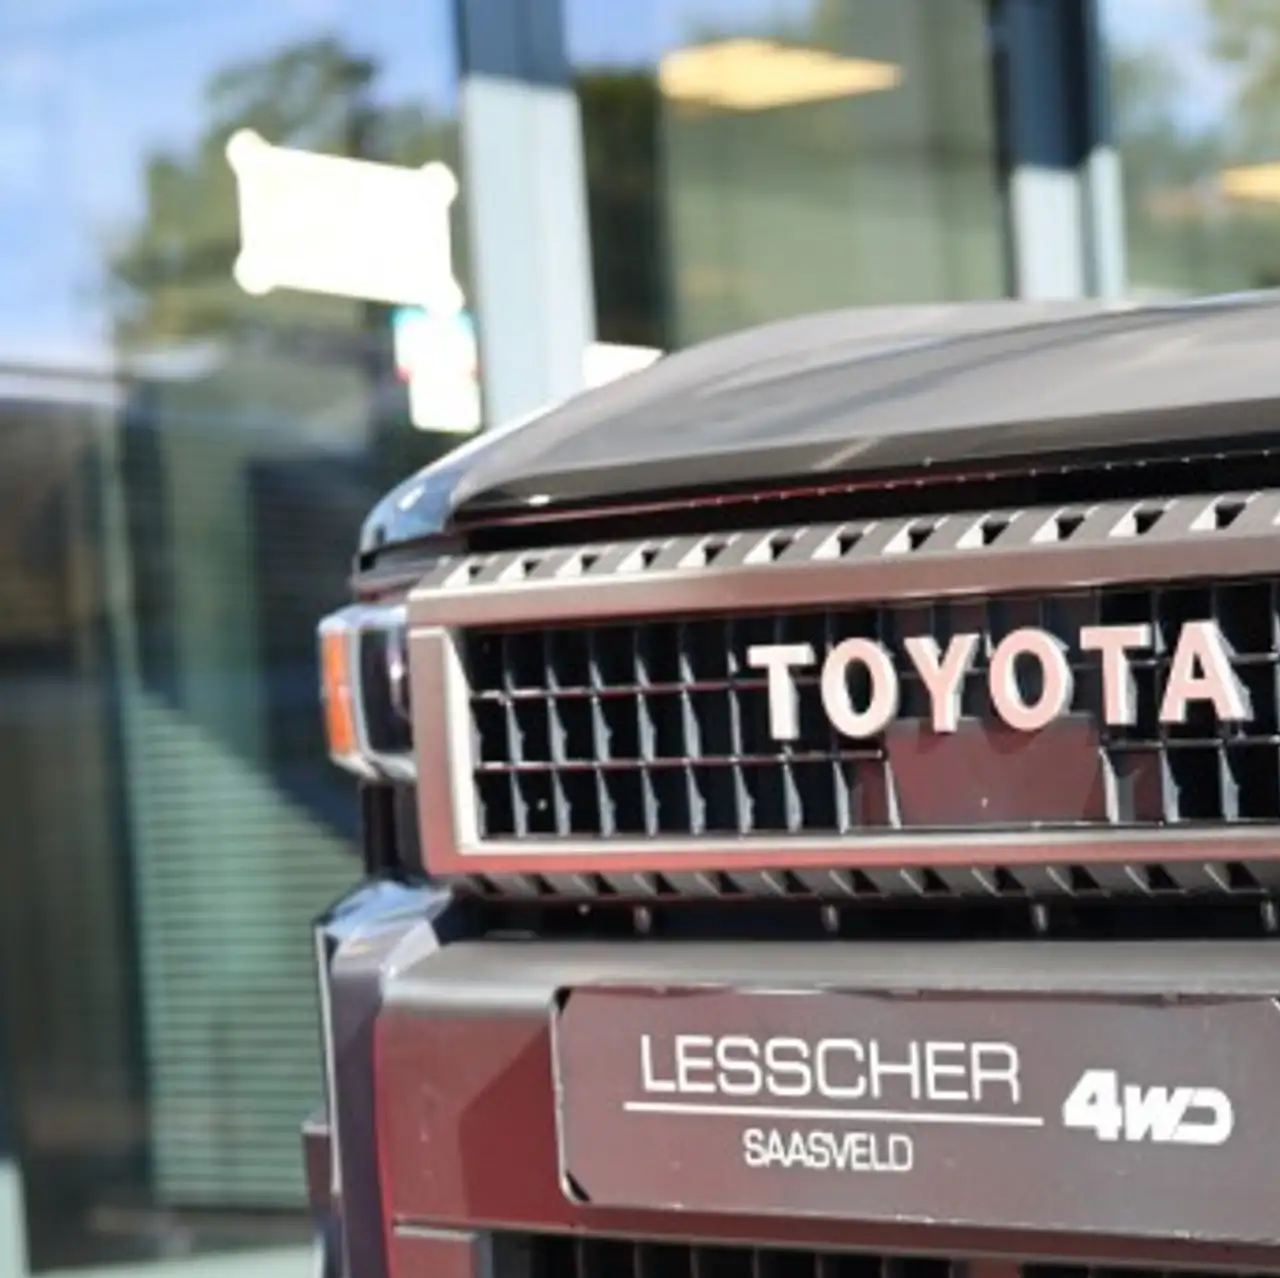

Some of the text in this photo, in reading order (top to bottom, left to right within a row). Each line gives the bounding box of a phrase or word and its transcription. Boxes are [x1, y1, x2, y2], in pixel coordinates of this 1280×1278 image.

[747, 619, 1255, 741] TOYOTA
[638, 1033, 1022, 1106] LESSCHER
[1061, 1068, 1235, 1147] 4WD
[742, 1129, 914, 1174] SAASVELD
